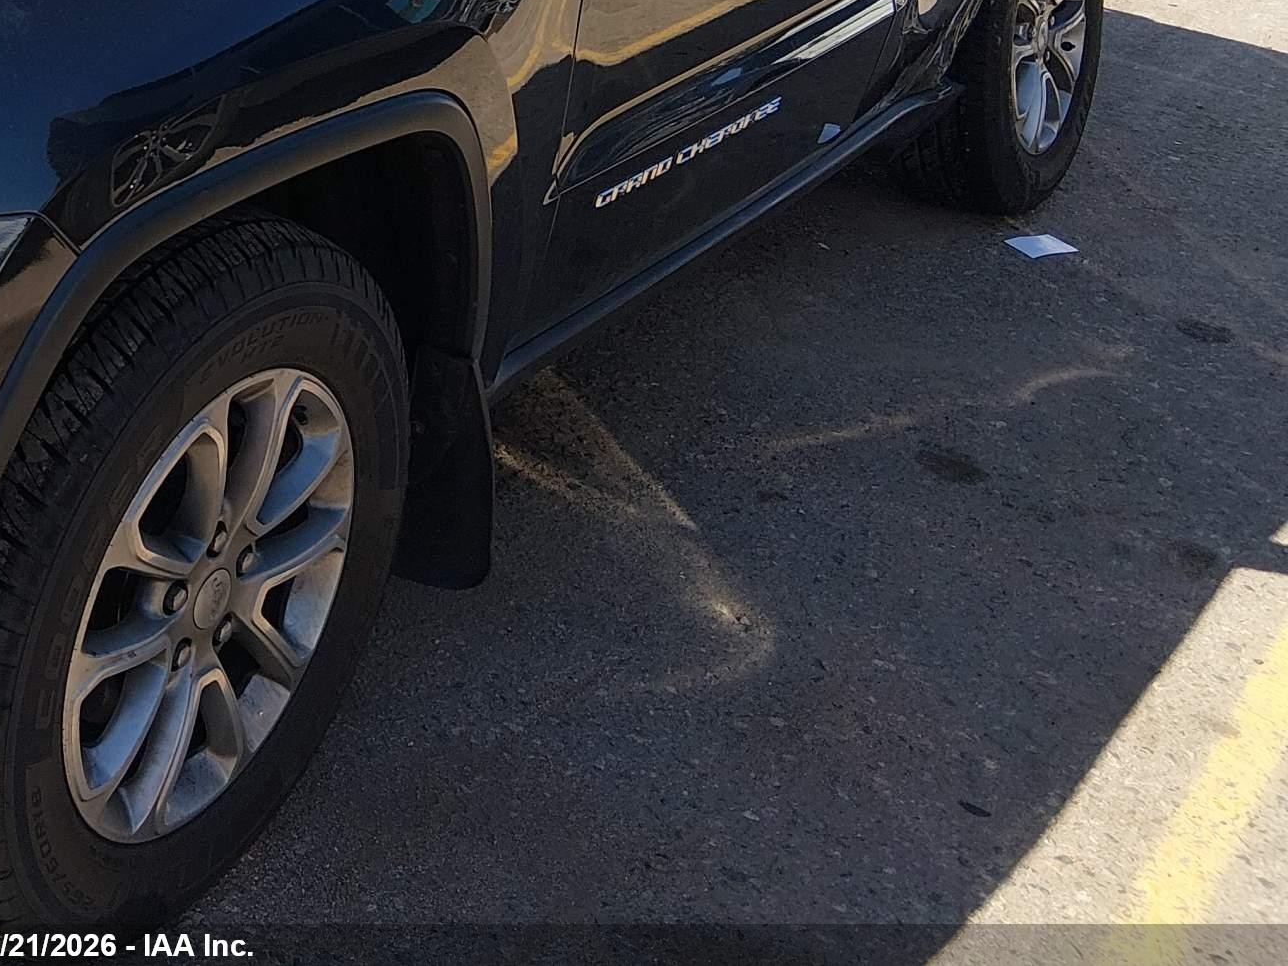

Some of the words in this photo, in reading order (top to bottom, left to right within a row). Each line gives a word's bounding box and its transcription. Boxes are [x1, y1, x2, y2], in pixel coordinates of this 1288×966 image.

[595, 156, 674, 208] GRAND
[675, 96, 783, 165] CHEROKEE
[198, 312, 324, 385] EVOLUTION
